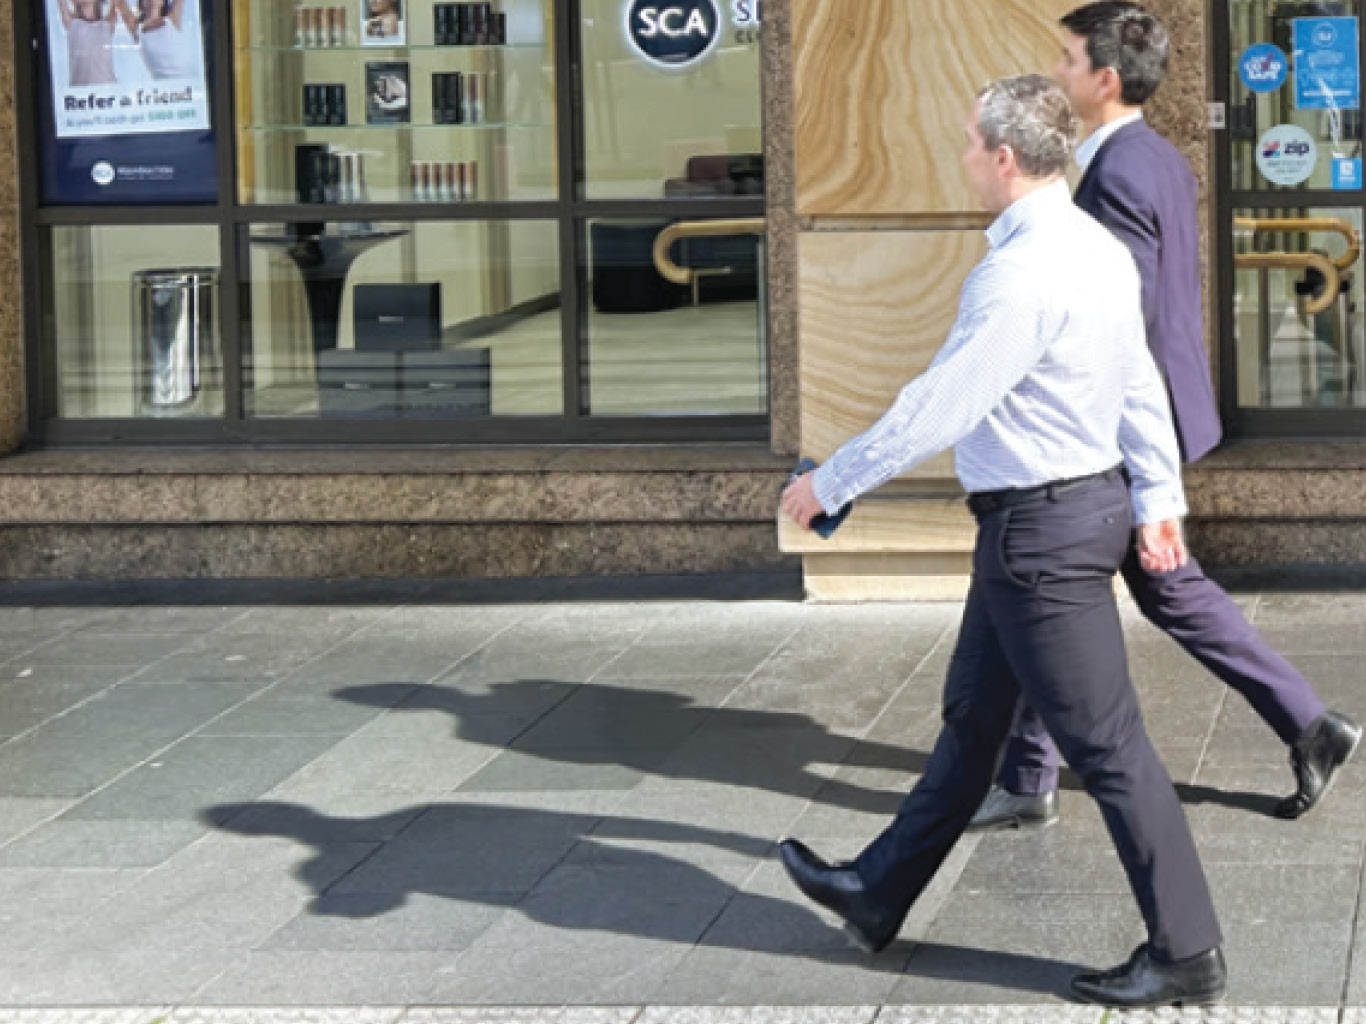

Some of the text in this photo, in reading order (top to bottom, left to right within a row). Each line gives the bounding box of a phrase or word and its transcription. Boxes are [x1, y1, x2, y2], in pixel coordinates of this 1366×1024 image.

[637, 7, 709, 37] SCA
[64, 86, 193, 111] Refer a friend
[1284, 139, 1310, 156] zip
